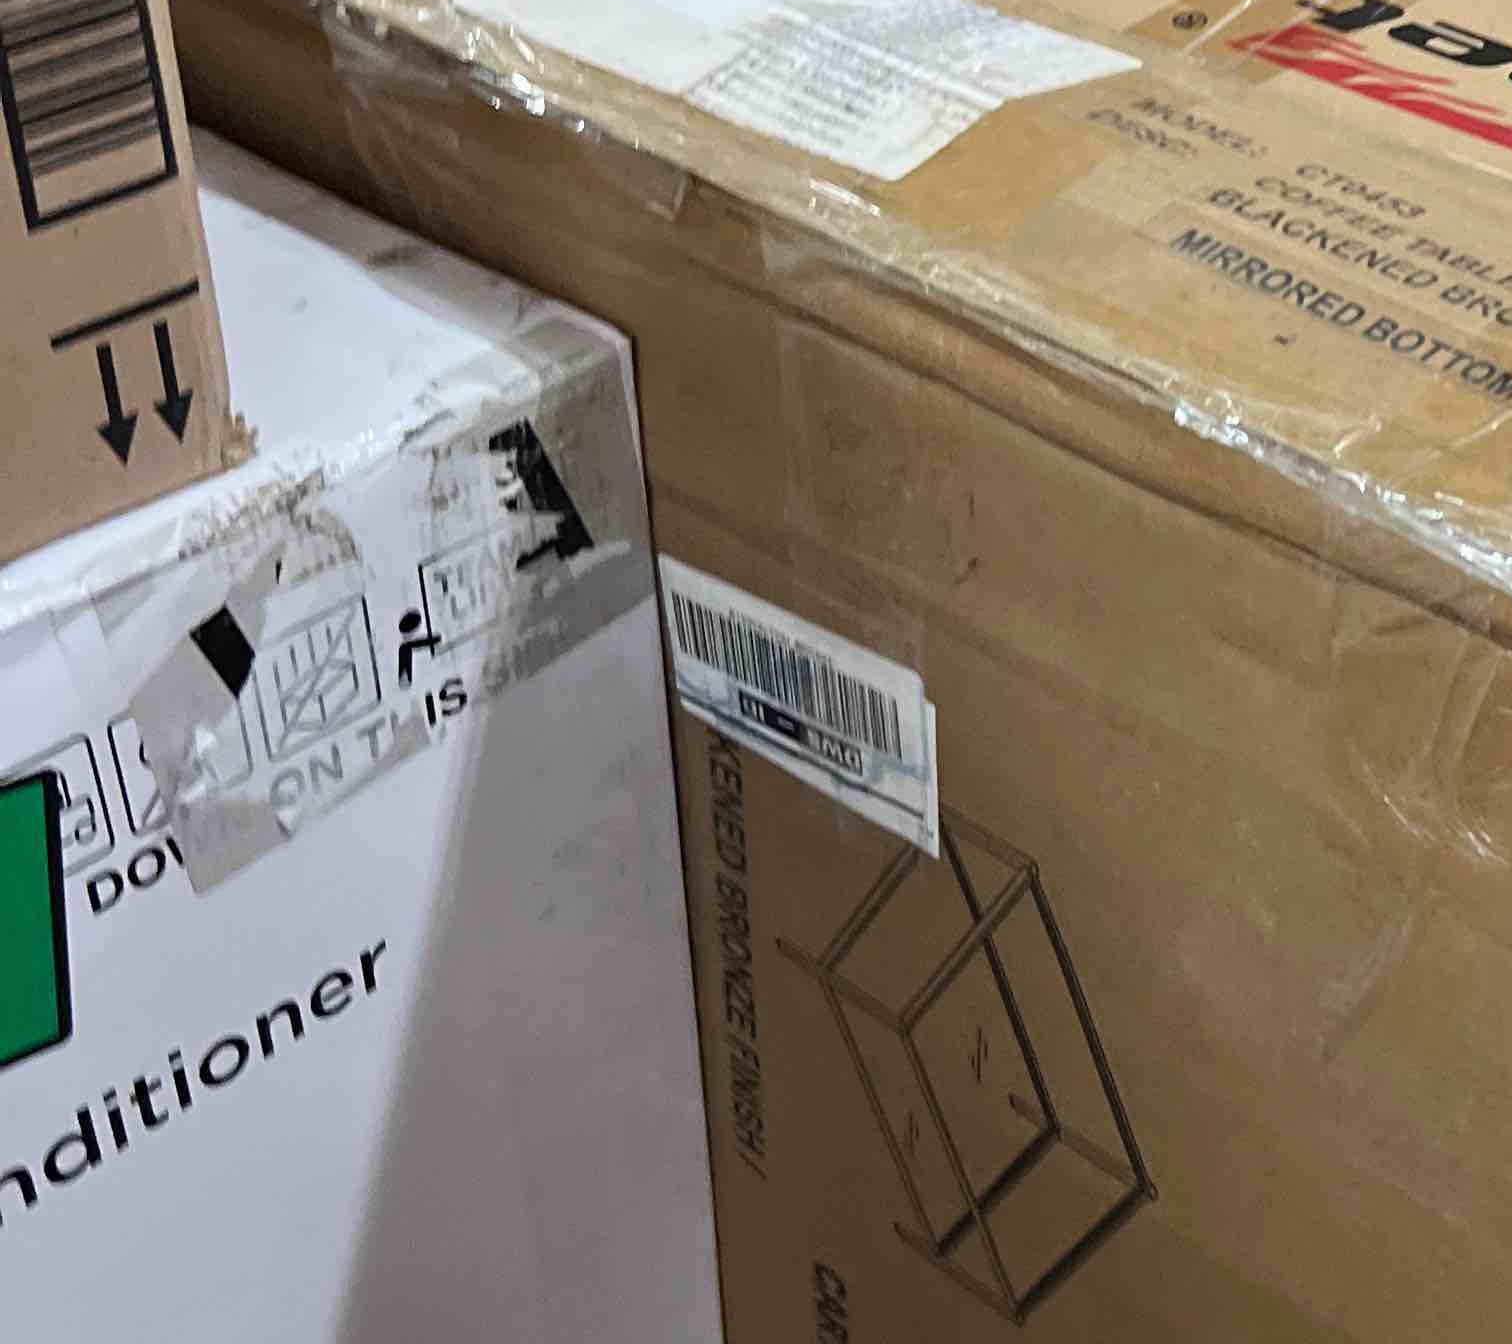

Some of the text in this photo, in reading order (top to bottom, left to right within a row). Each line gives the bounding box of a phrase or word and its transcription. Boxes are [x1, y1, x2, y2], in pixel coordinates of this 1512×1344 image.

[1255, 174, 1407, 244] COFFEE
[1294, 161, 1427, 219] CT0453
[1169, 227, 1365, 327] MIRRORED
[1206, 186, 1438, 291] BLACKENED
